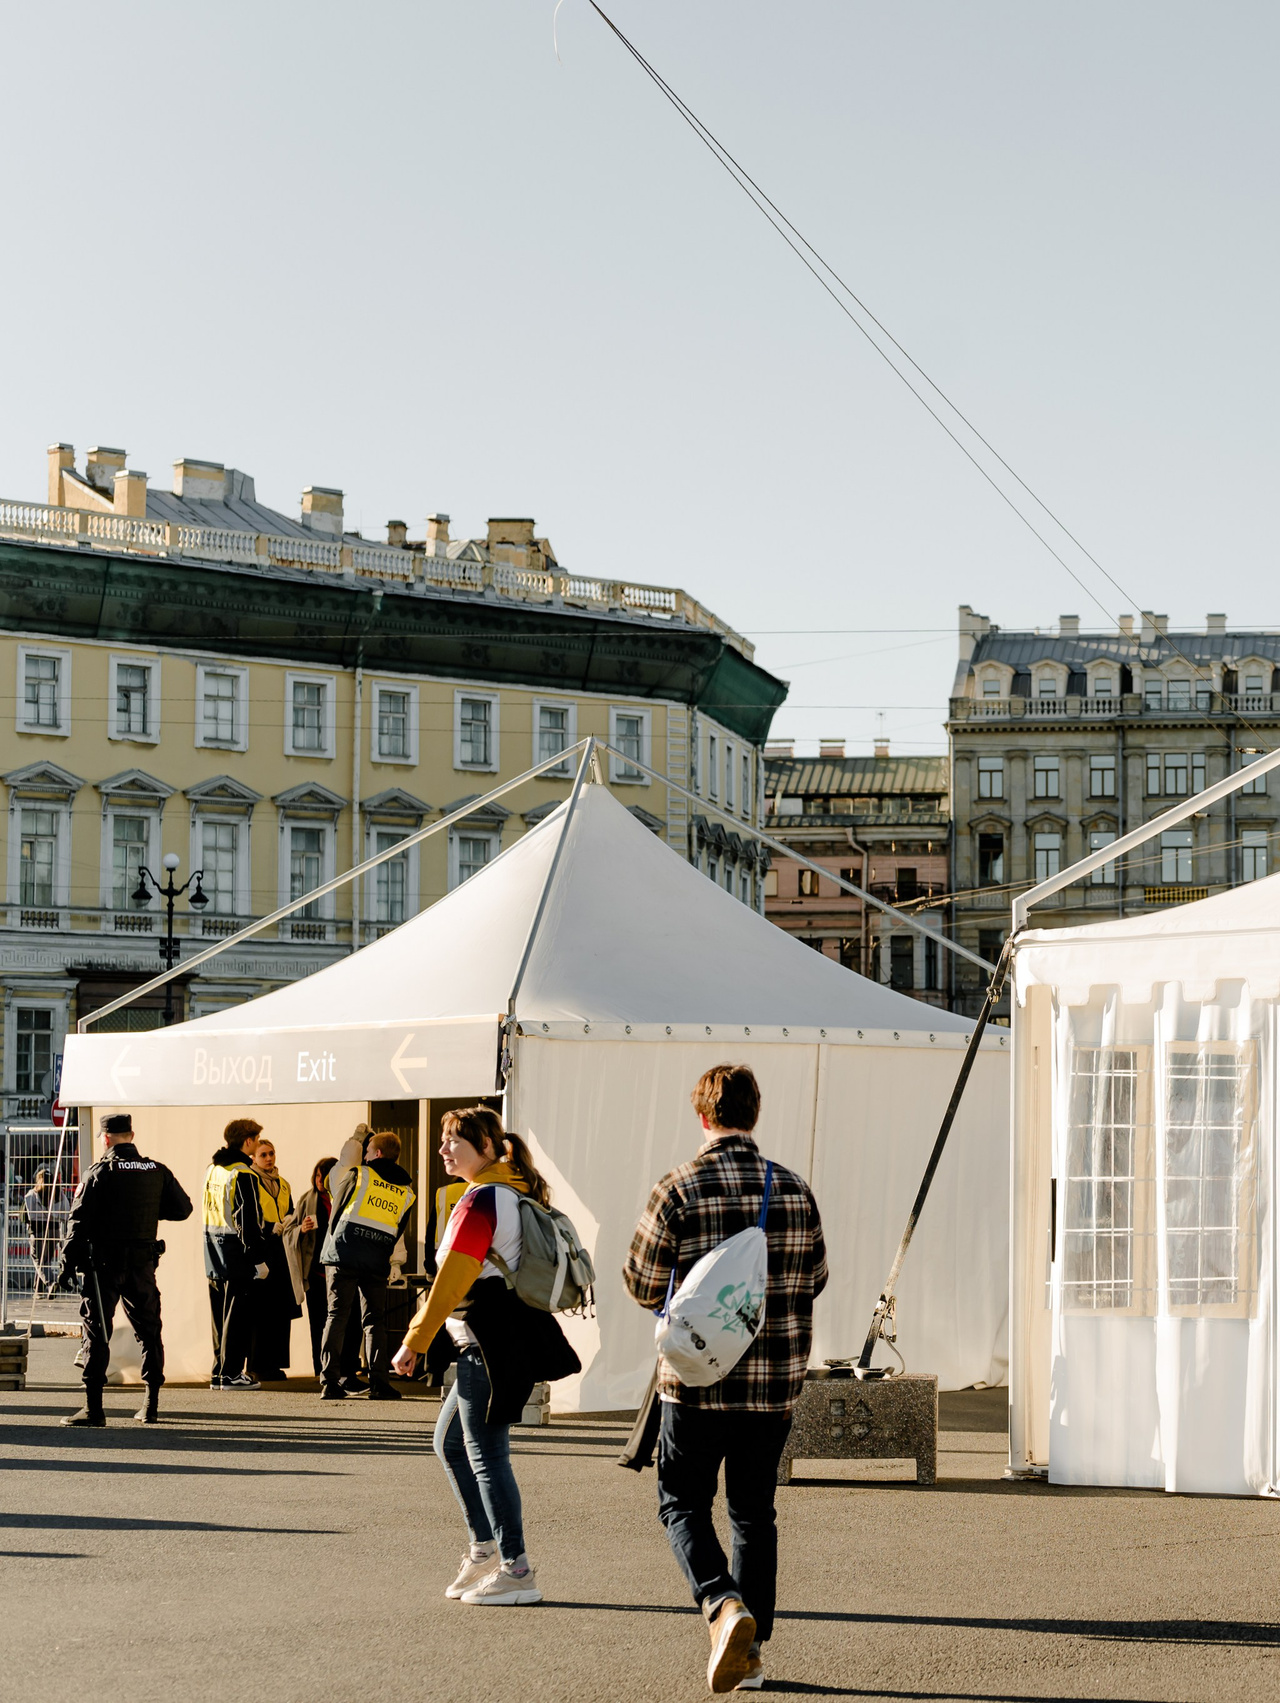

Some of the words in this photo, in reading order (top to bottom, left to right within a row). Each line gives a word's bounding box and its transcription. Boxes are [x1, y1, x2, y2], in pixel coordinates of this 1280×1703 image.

[193, 1047, 273, 1092] Выход
[297, 1050, 337, 1082] Exit
[118, 1161, 157, 1170] ПОЛИЦИЯ
[373, 1179, 405, 1197] SAFETY
[367, 1195, 399, 1215] K0053
[353, 1226, 393, 1245] STEWARD
